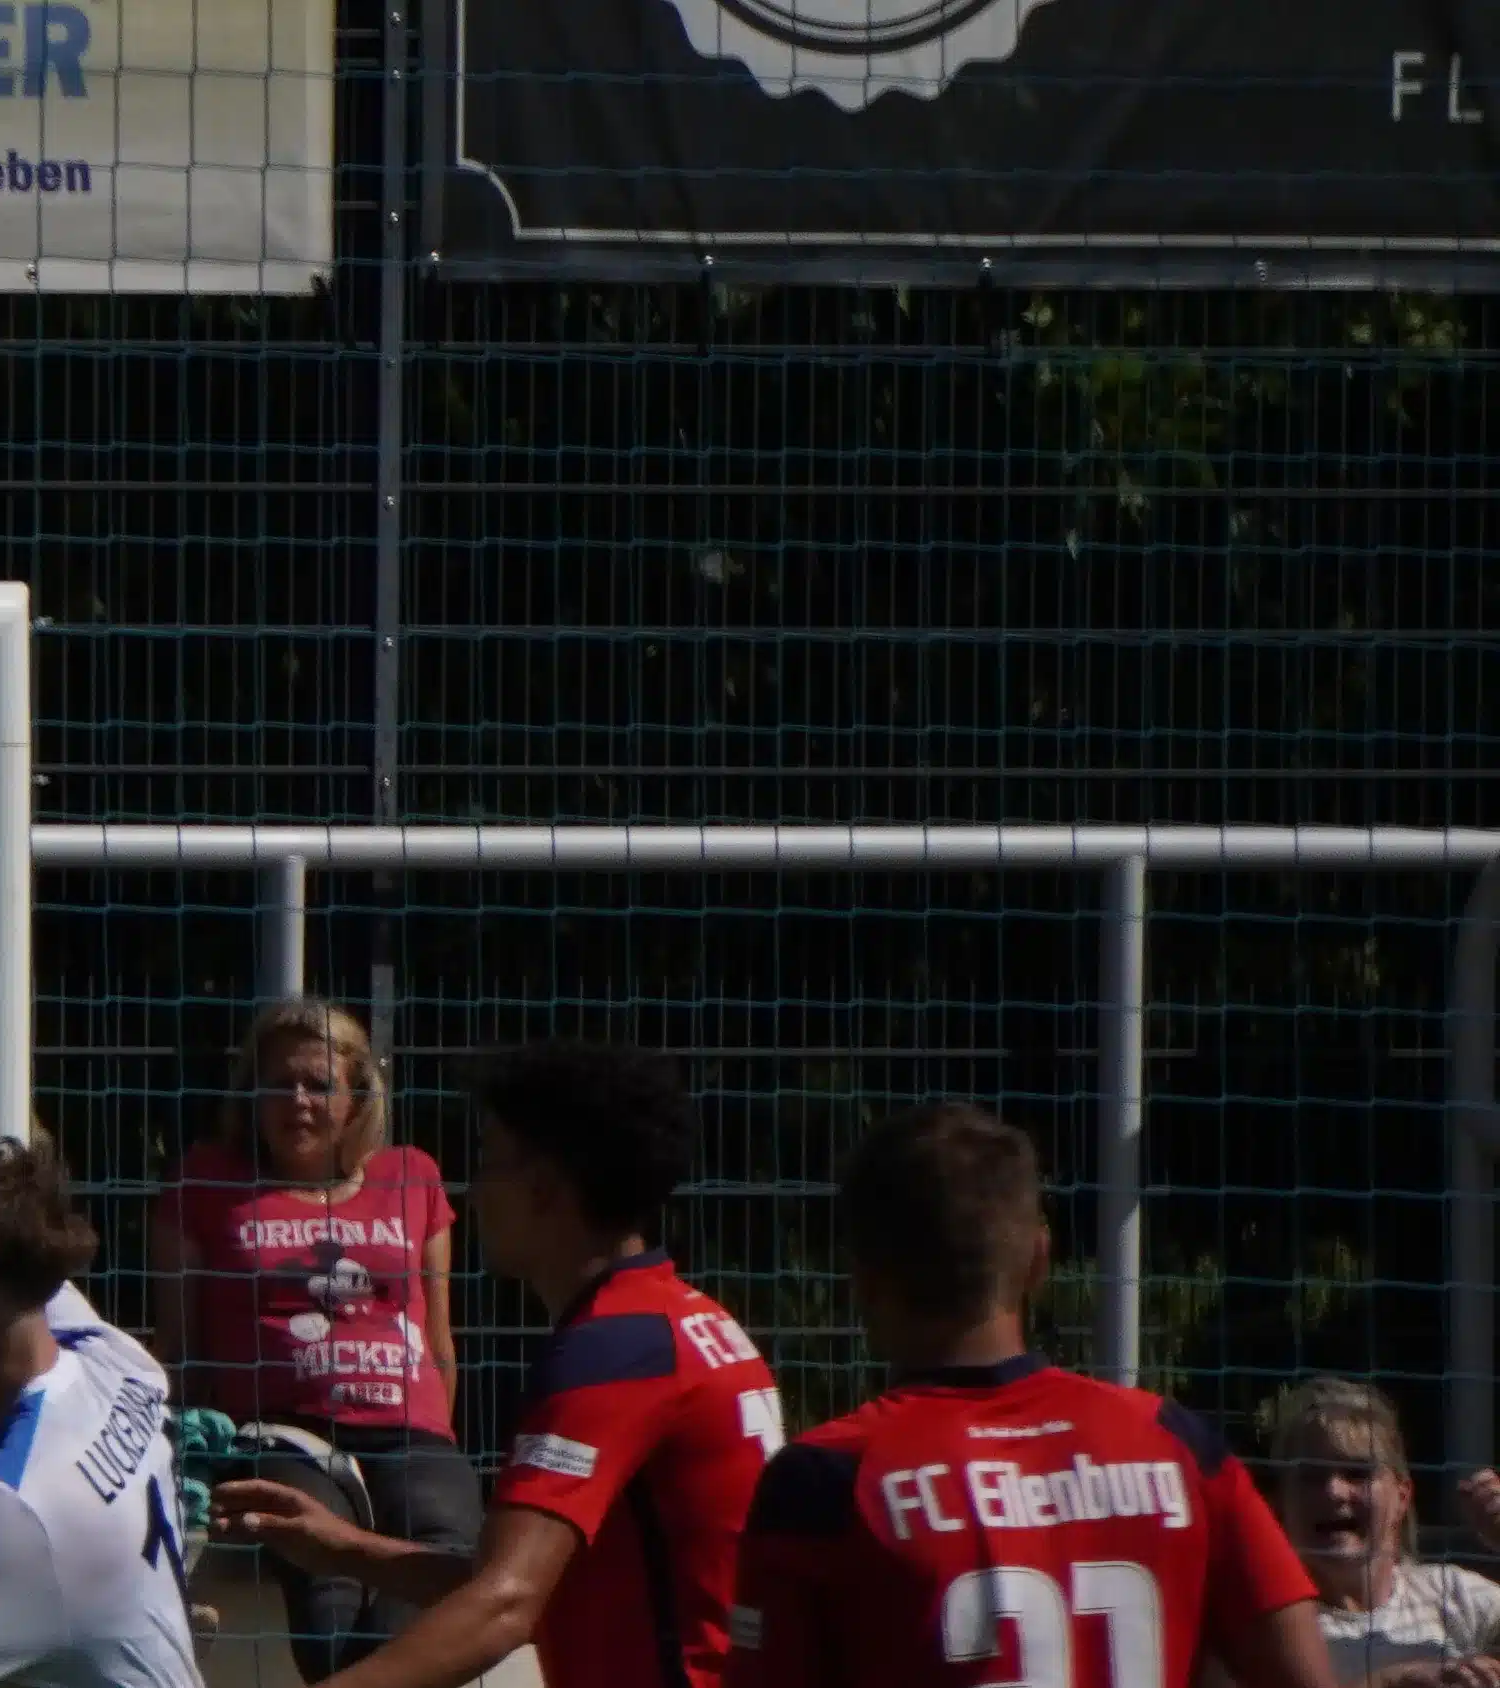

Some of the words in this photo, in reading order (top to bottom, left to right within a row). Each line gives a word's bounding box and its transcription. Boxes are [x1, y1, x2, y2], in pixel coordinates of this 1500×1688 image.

[239, 1216, 414, 1250] ORIGINAL
[884, 1463, 966, 1541] FC
[967, 1453, 1192, 1529] Eilenburg
